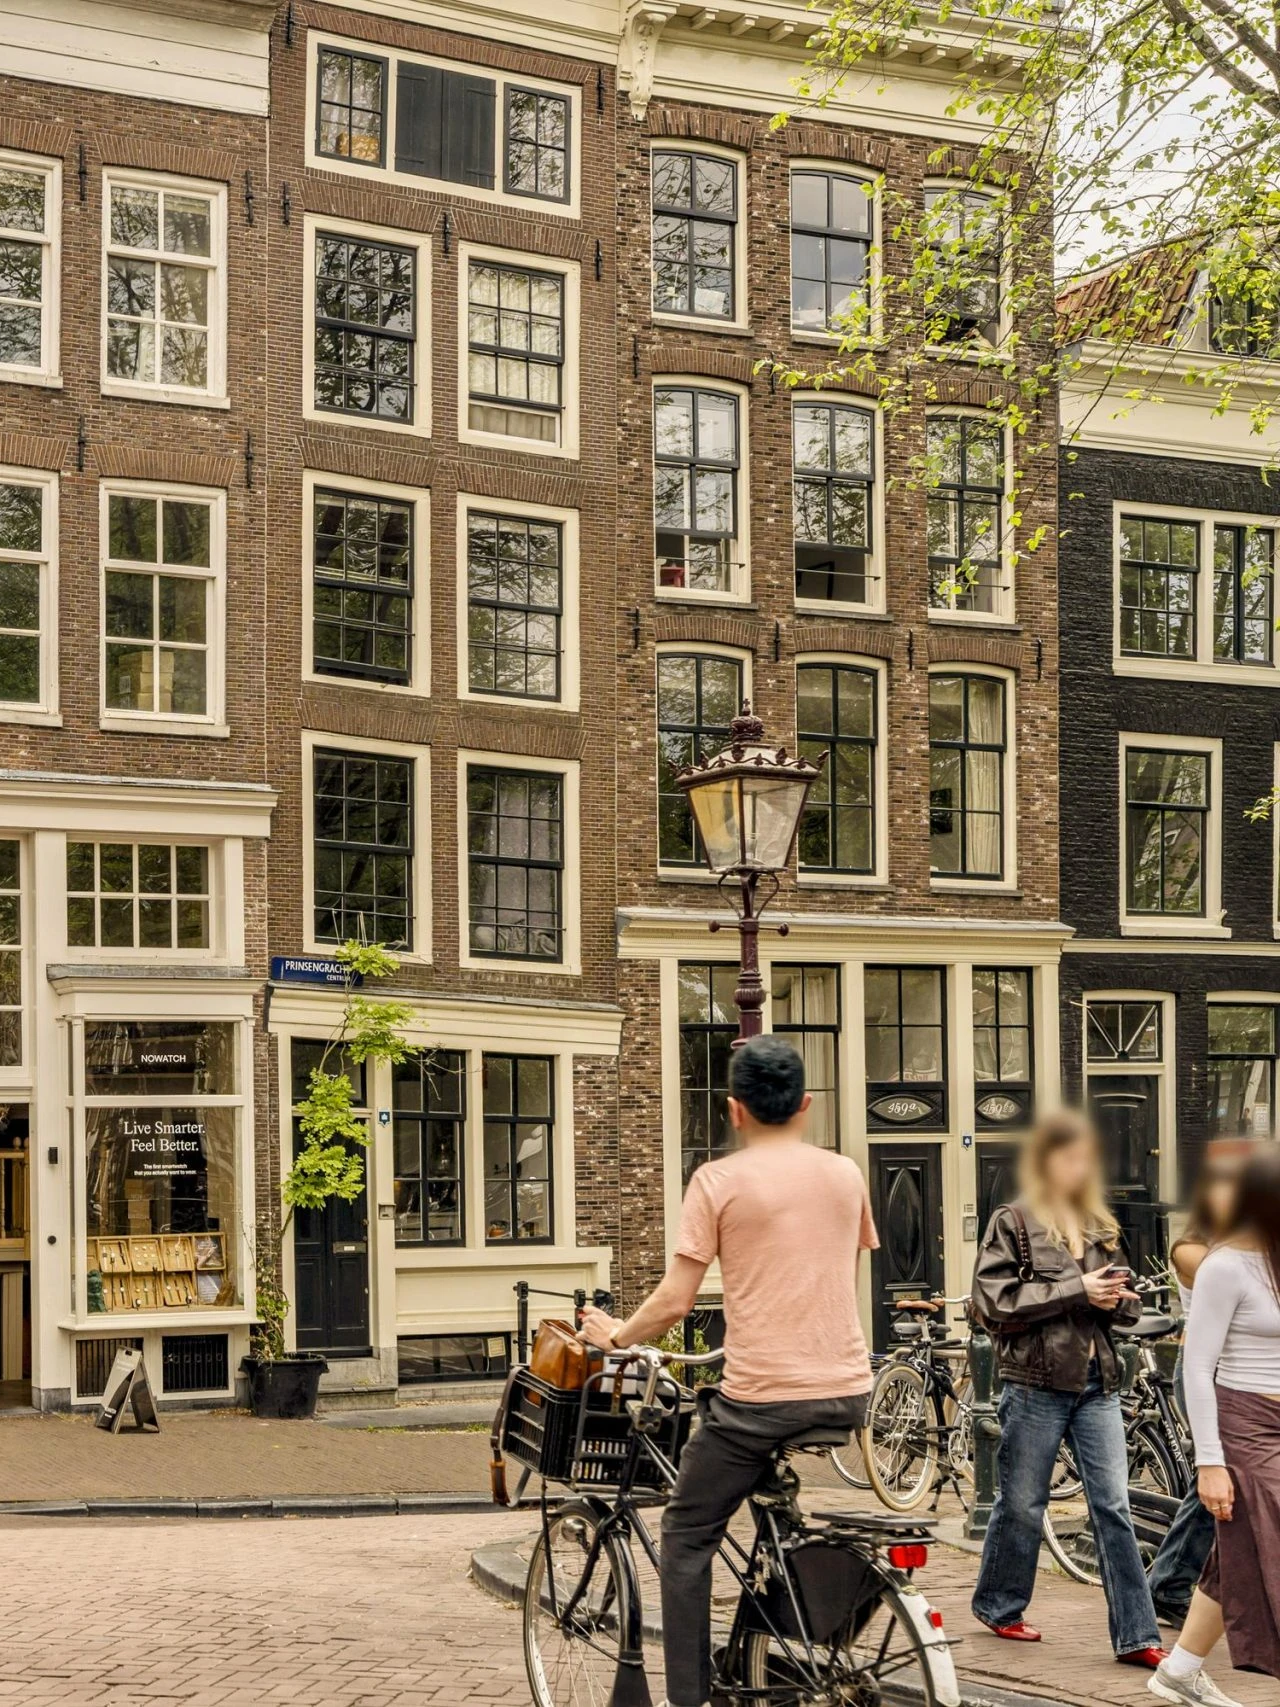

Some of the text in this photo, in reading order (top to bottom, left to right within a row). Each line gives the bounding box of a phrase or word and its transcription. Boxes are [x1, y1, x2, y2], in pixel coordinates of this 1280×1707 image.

[141, 1054, 187, 1063] NOWATCH
[124, 1121, 206, 1135] Live Smarter.
[131, 1138, 199, 1152] Feel Better.
